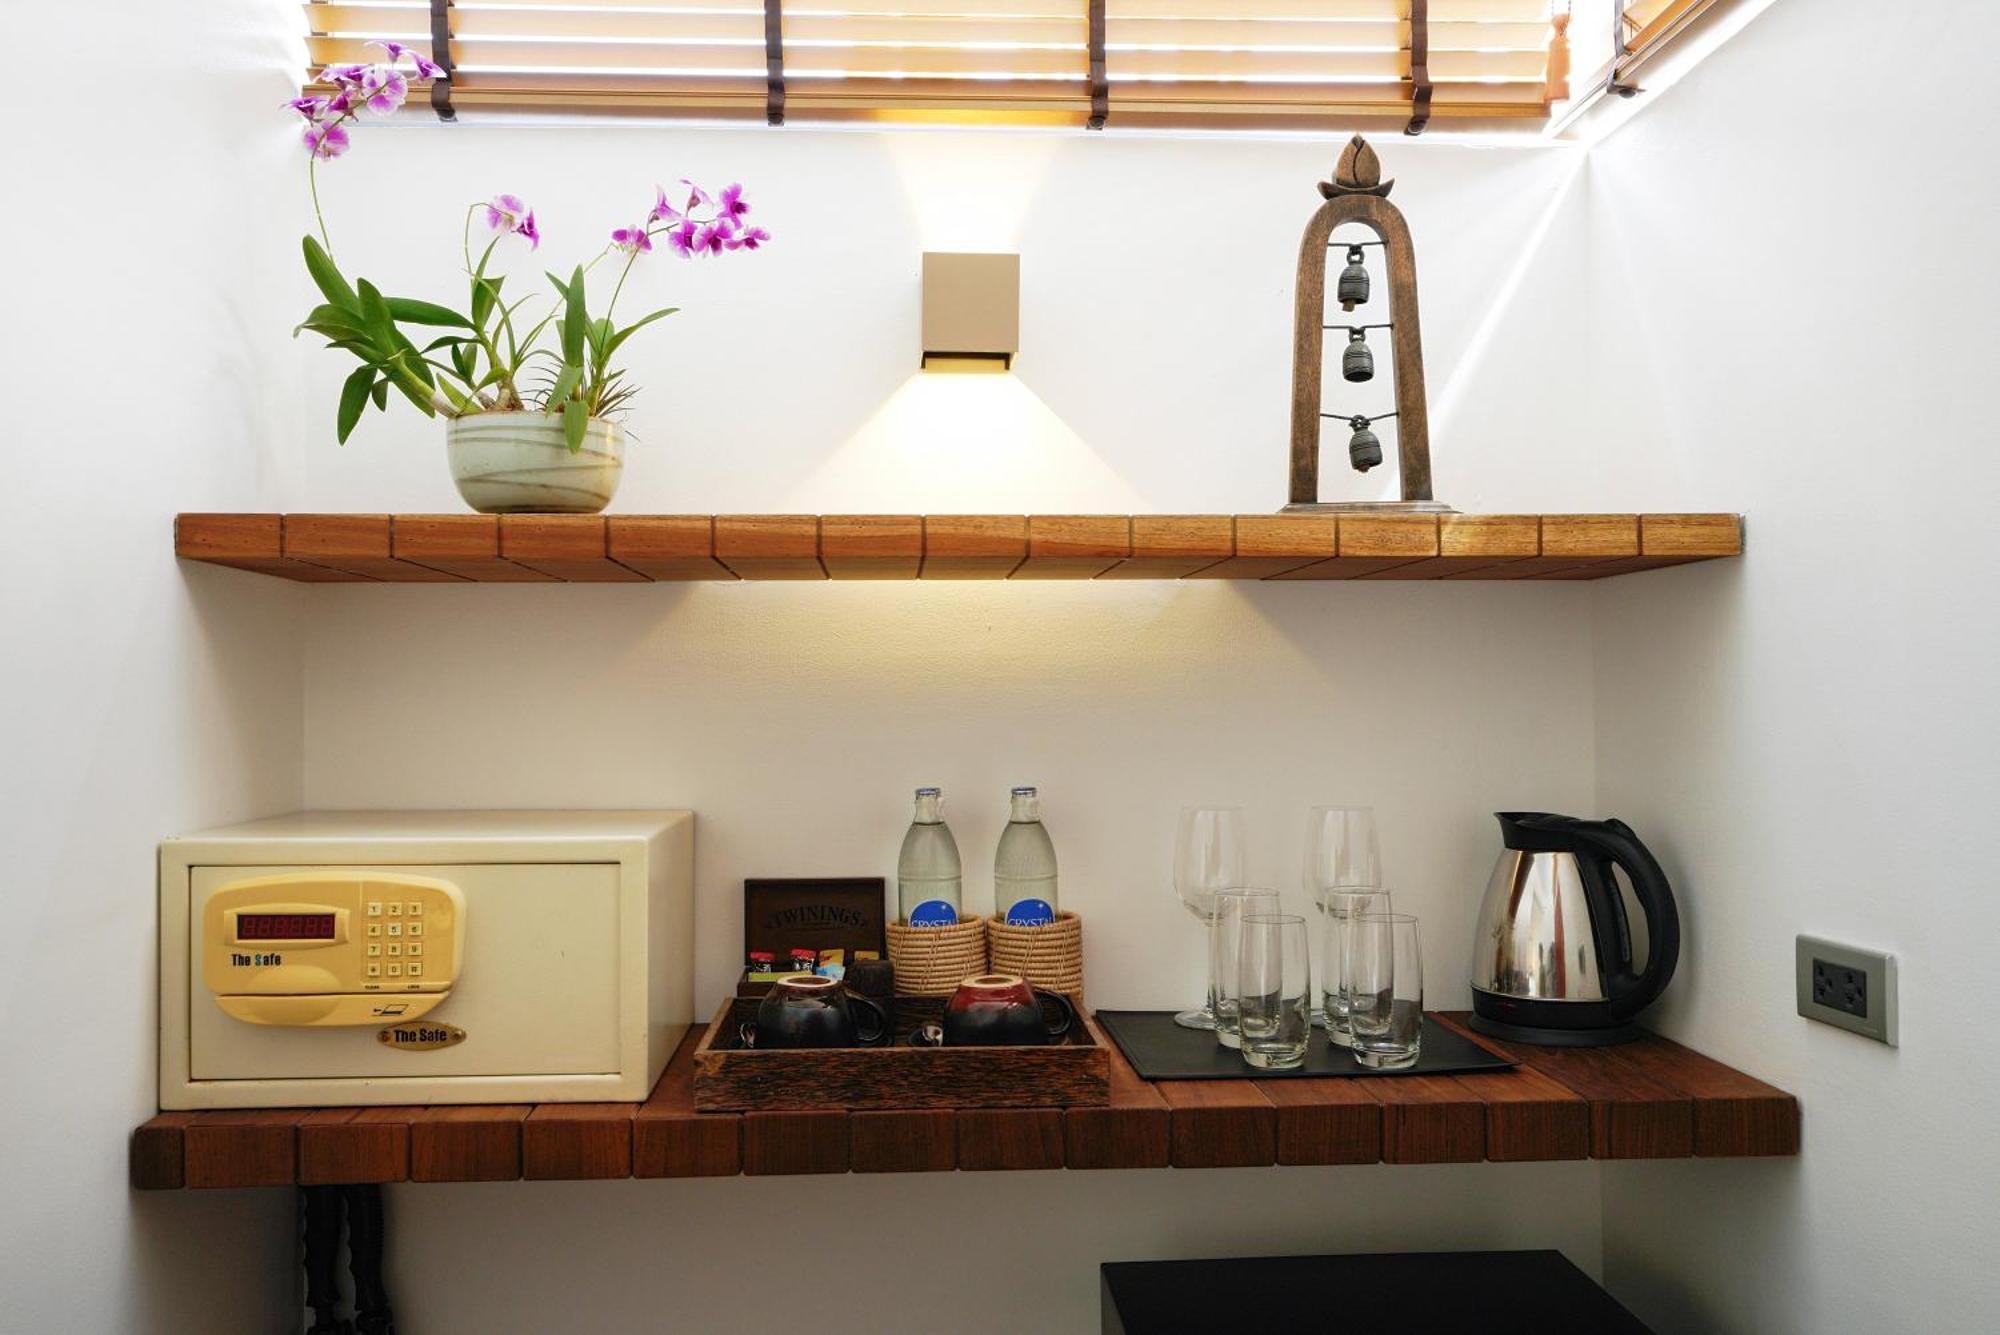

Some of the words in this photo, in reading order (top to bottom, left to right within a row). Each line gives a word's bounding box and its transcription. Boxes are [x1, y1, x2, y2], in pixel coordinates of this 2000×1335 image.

[771, 904, 862, 928] TWININGS
[231, 953, 251, 967] The
[254, 952, 282, 966] Safe
[394, 1030, 417, 1043] The
[419, 1029, 448, 1042] Safe
